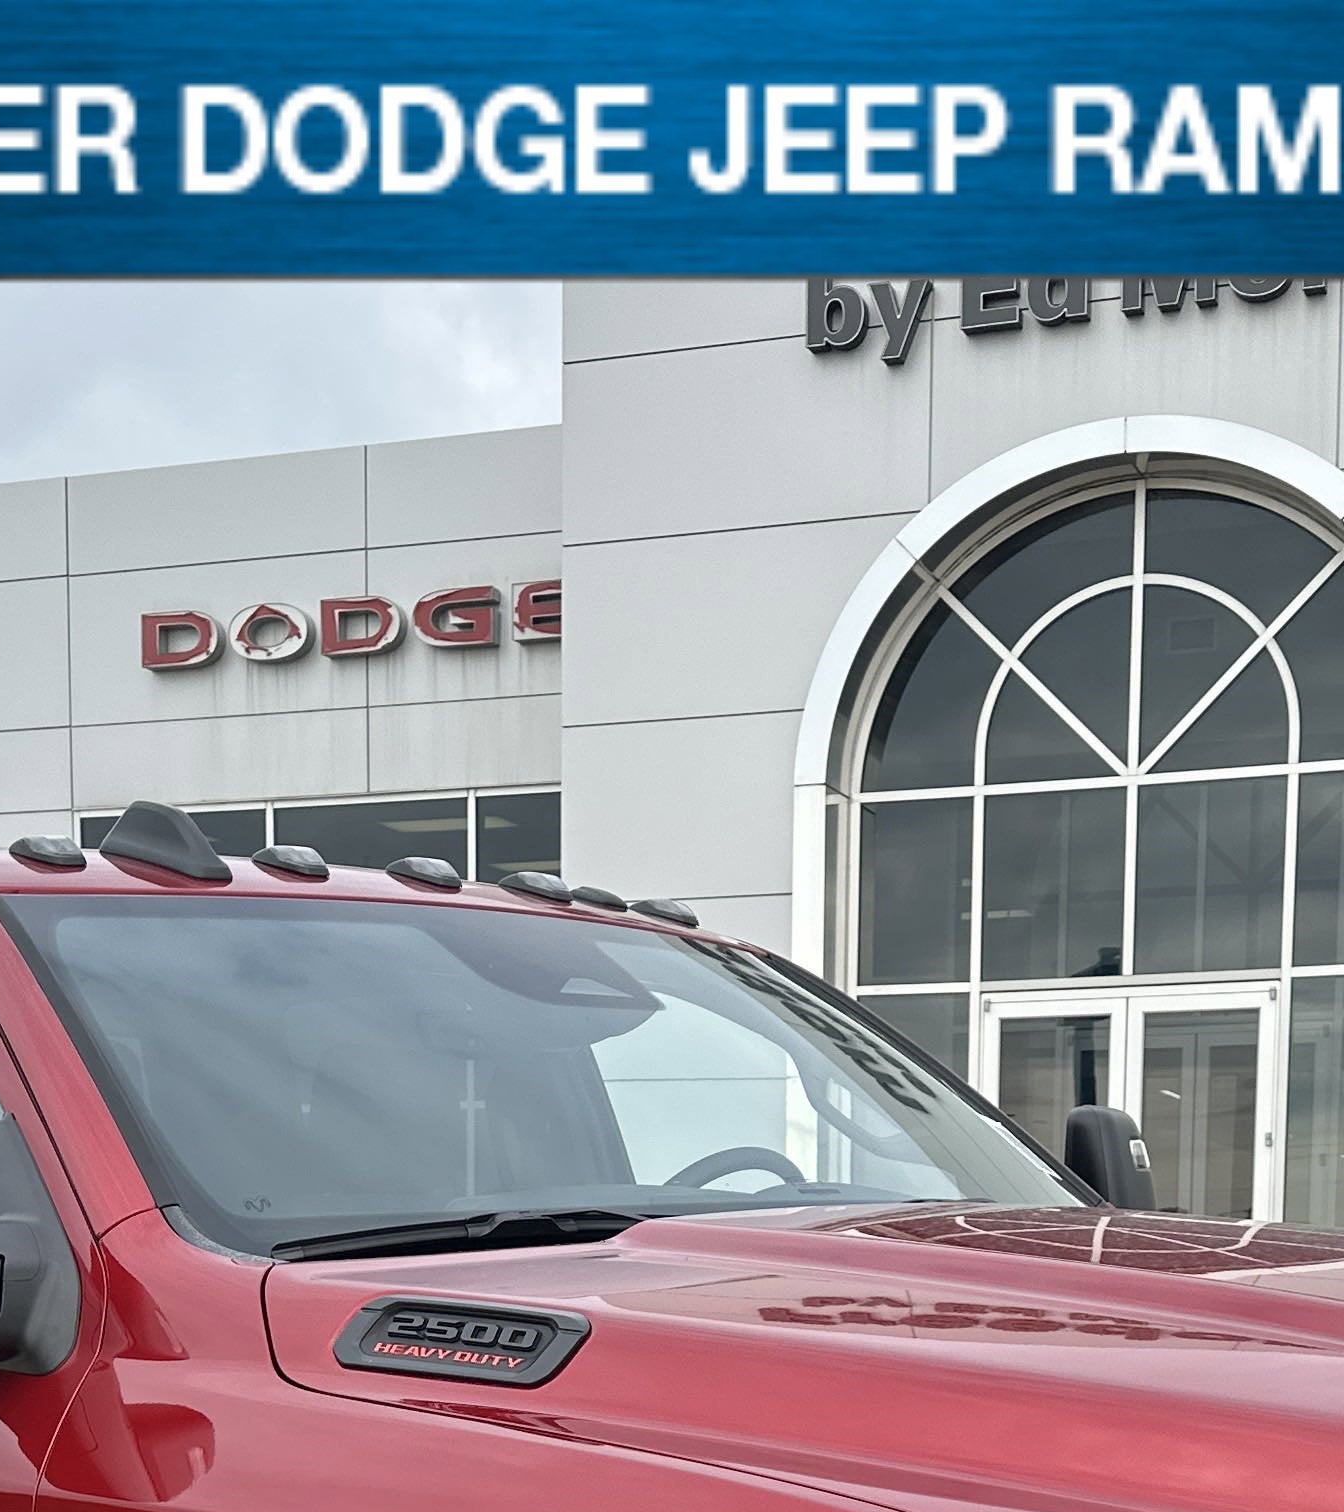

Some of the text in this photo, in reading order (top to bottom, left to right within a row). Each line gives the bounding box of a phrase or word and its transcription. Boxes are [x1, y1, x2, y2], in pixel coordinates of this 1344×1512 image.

[805, 277, 933, 364] by
[140, 579, 562, 673] DODGE
[372, 1341, 525, 1369] HEAVY DUTY
[386, 1314, 542, 1352] 2500
